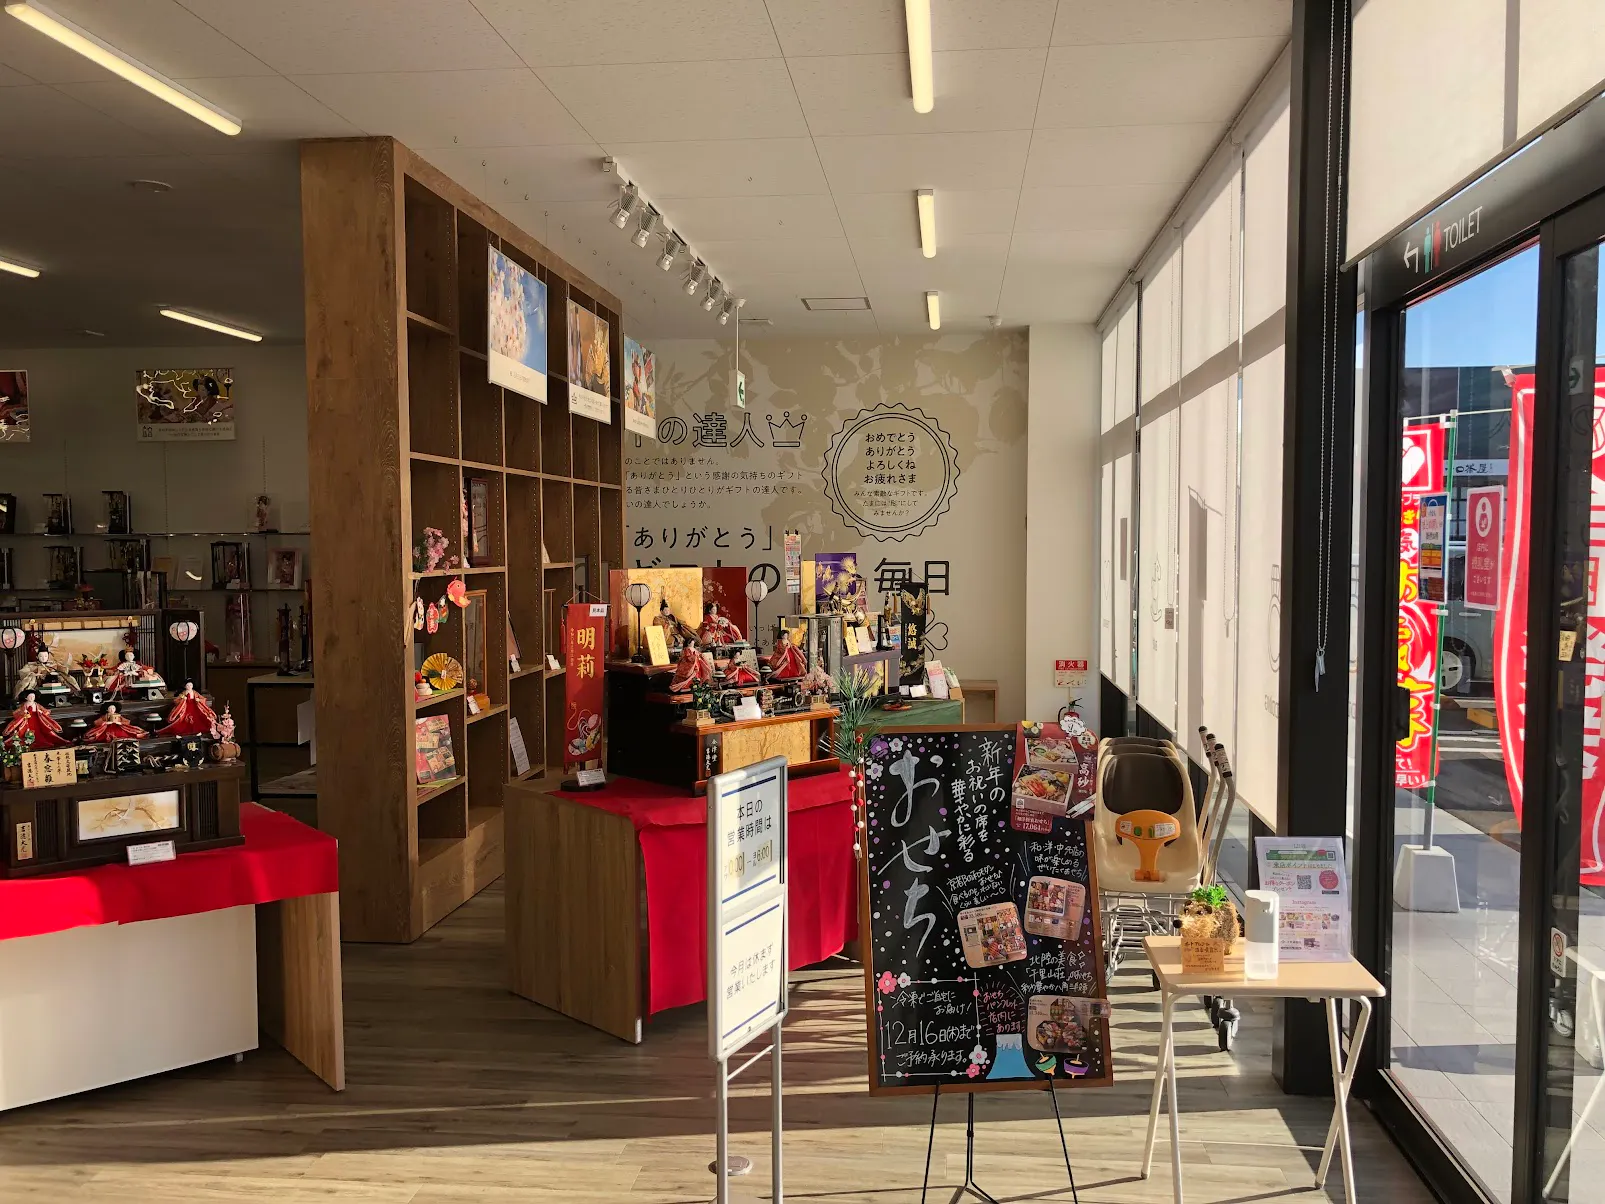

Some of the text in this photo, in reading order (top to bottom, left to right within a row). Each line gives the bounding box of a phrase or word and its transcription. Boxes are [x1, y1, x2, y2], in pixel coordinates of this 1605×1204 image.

[1443, 206, 1483, 252] TOILET
[634, 411, 765, 448] の達人
[865, 432, 915, 443] おめでとう
[865, 445, 915, 456] ありがとう
[866, 460, 916, 470] よろしくね
[864, 473, 917, 485] お疲れさま
[625, 525, 773, 551] ありがとう」
[874, 557, 950, 596] 毎日
[576, 626, 596, 680] 明莉
[1058, 660, 1085, 668] 消火器
[978, 737, 1006, 802] 新年の
[736, 799, 763, 821] 本日の
[965, 759, 990, 842] お祝いの席を
[727, 815, 772, 847] 営業時間は
[951, 779, 976, 864] 華やかに彩る
[877, 749, 953, 958] おせち
[729, 942, 773, 978] 今月は休まず
[726, 959, 776, 1000] 営業いたします
[890, 990, 957, 1009] 冷凍でご自宅に
[983, 990, 1004, 1003] おせち
[987, 999, 1018, 1011] パンフレット
[988, 1010, 1017, 1024] 店内に
[996, 1021, 1021, 1034] あります
[896, 1049, 967, 1068] ご予約承ります。
